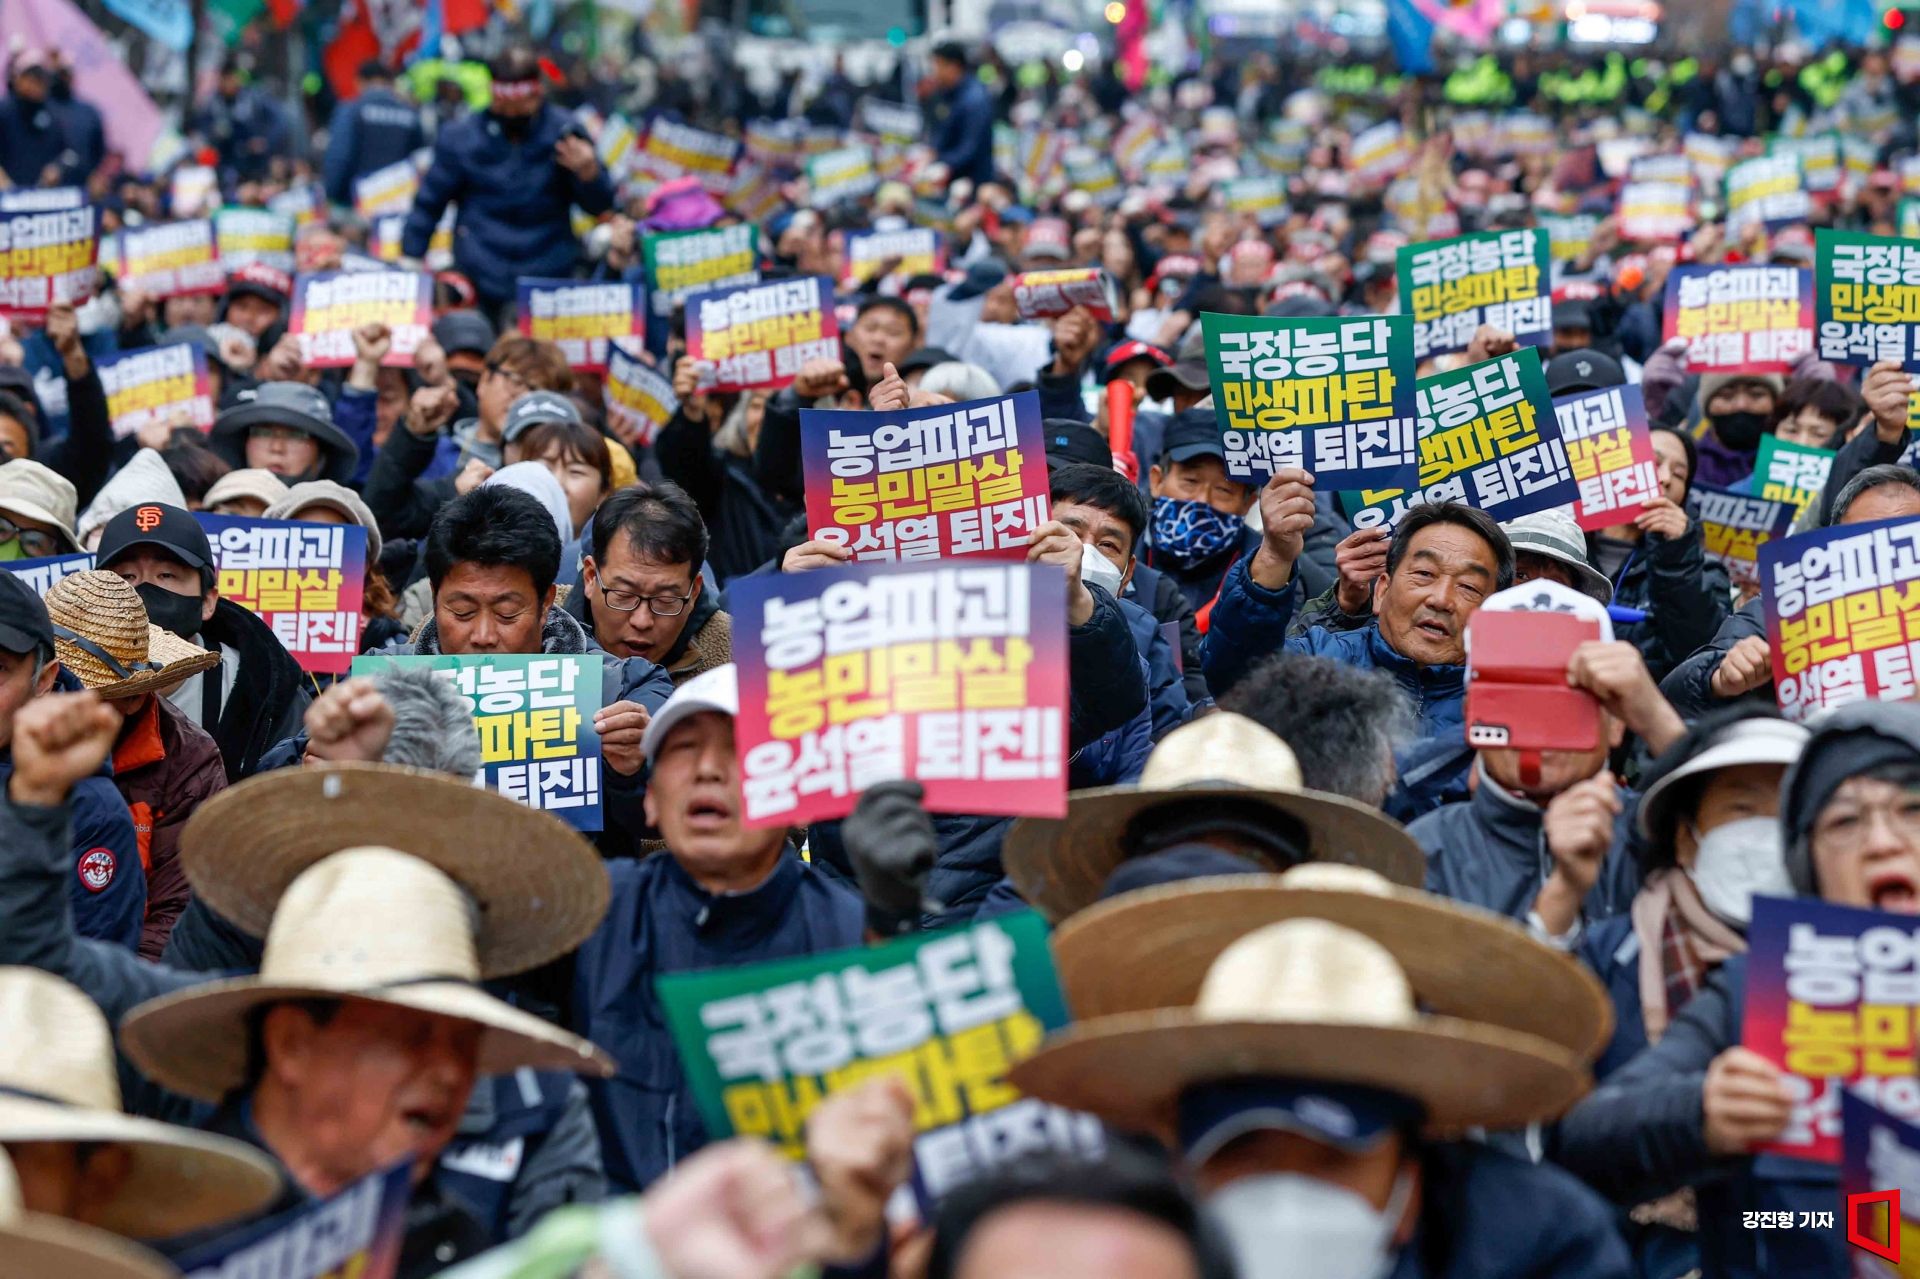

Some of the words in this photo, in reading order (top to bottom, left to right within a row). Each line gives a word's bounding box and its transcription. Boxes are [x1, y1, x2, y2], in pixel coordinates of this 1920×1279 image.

[1411, 230, 1537, 286] 국정농단
[699, 277, 820, 331] 농업파괴
[1412, 265, 1540, 321] 민생파탄
[1679, 267, 1799, 308] 농업파괴
[1219, 319, 1392, 380] 국정농단
[1820, 321, 1906, 361] 윤석열
[1222, 369, 1397, 430] 민생파탄
[827, 399, 1019, 477] 농업파괴
[1223, 430, 1303, 477] 윤석열
[1314, 417, 1415, 473] 퇴진!
[830, 449, 1024, 525] 농민말살
[1471, 438, 1571, 509] 퇴진!
[1577, 460, 1659, 517] 퇴진!
[1768, 450, 1833, 494] 국정
[136, 506, 163, 532] SF
[272, 612, 358, 653] 퇴진!
[761, 565, 1031, 668] 농업파괴
[766, 637, 1034, 739] 농민말살
[498, 757, 599, 810] 퇴진!
[744, 714, 906, 820] 윤석열
[916, 707, 1060, 781] 퇴진!
[700, 920, 1023, 1084] 국정농단
